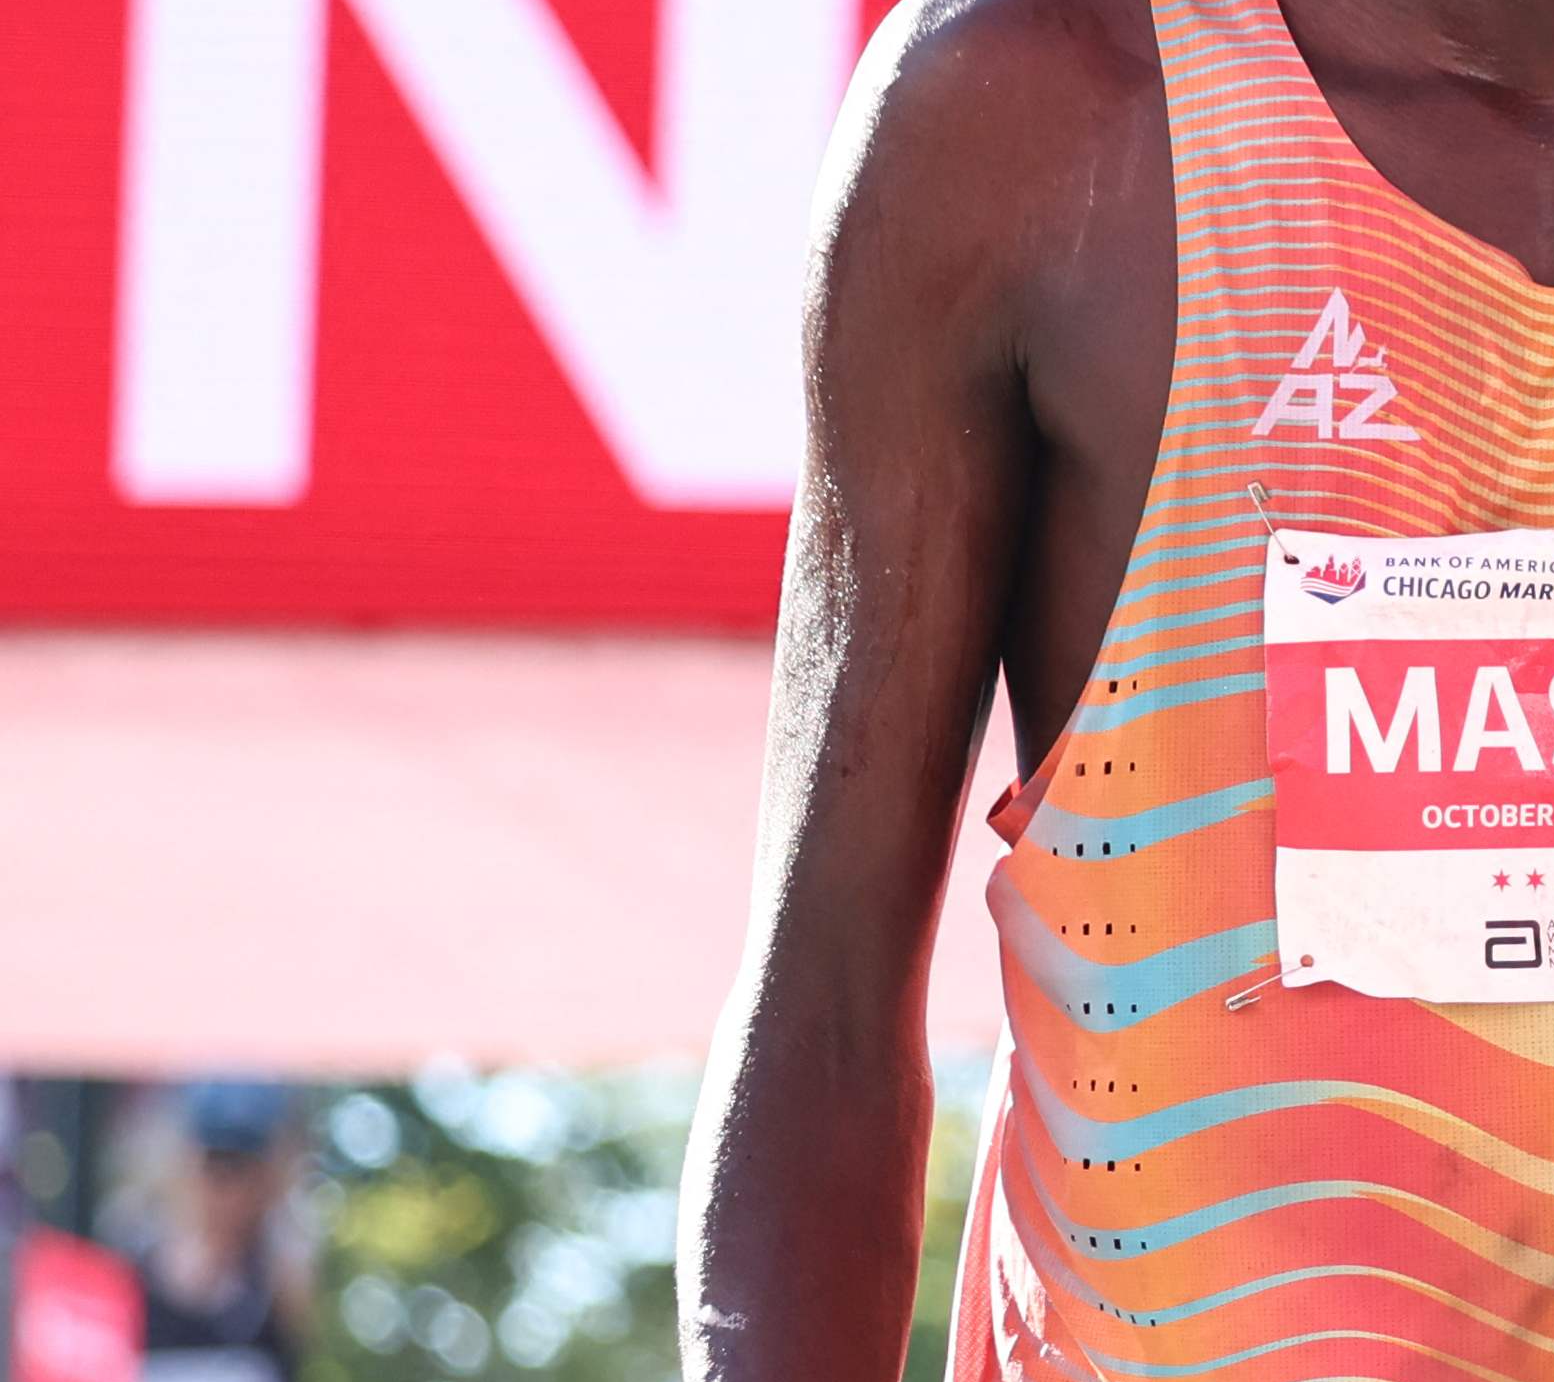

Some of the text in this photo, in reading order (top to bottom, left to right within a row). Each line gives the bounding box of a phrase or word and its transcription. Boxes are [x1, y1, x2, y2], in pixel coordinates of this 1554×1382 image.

[1384, 556, 1442, 571] BANK
[1448, 556, 1474, 571] OF
[1382, 575, 1491, 601] CHICAGO
[1421, 803, 1554, 830] OCTOBER
